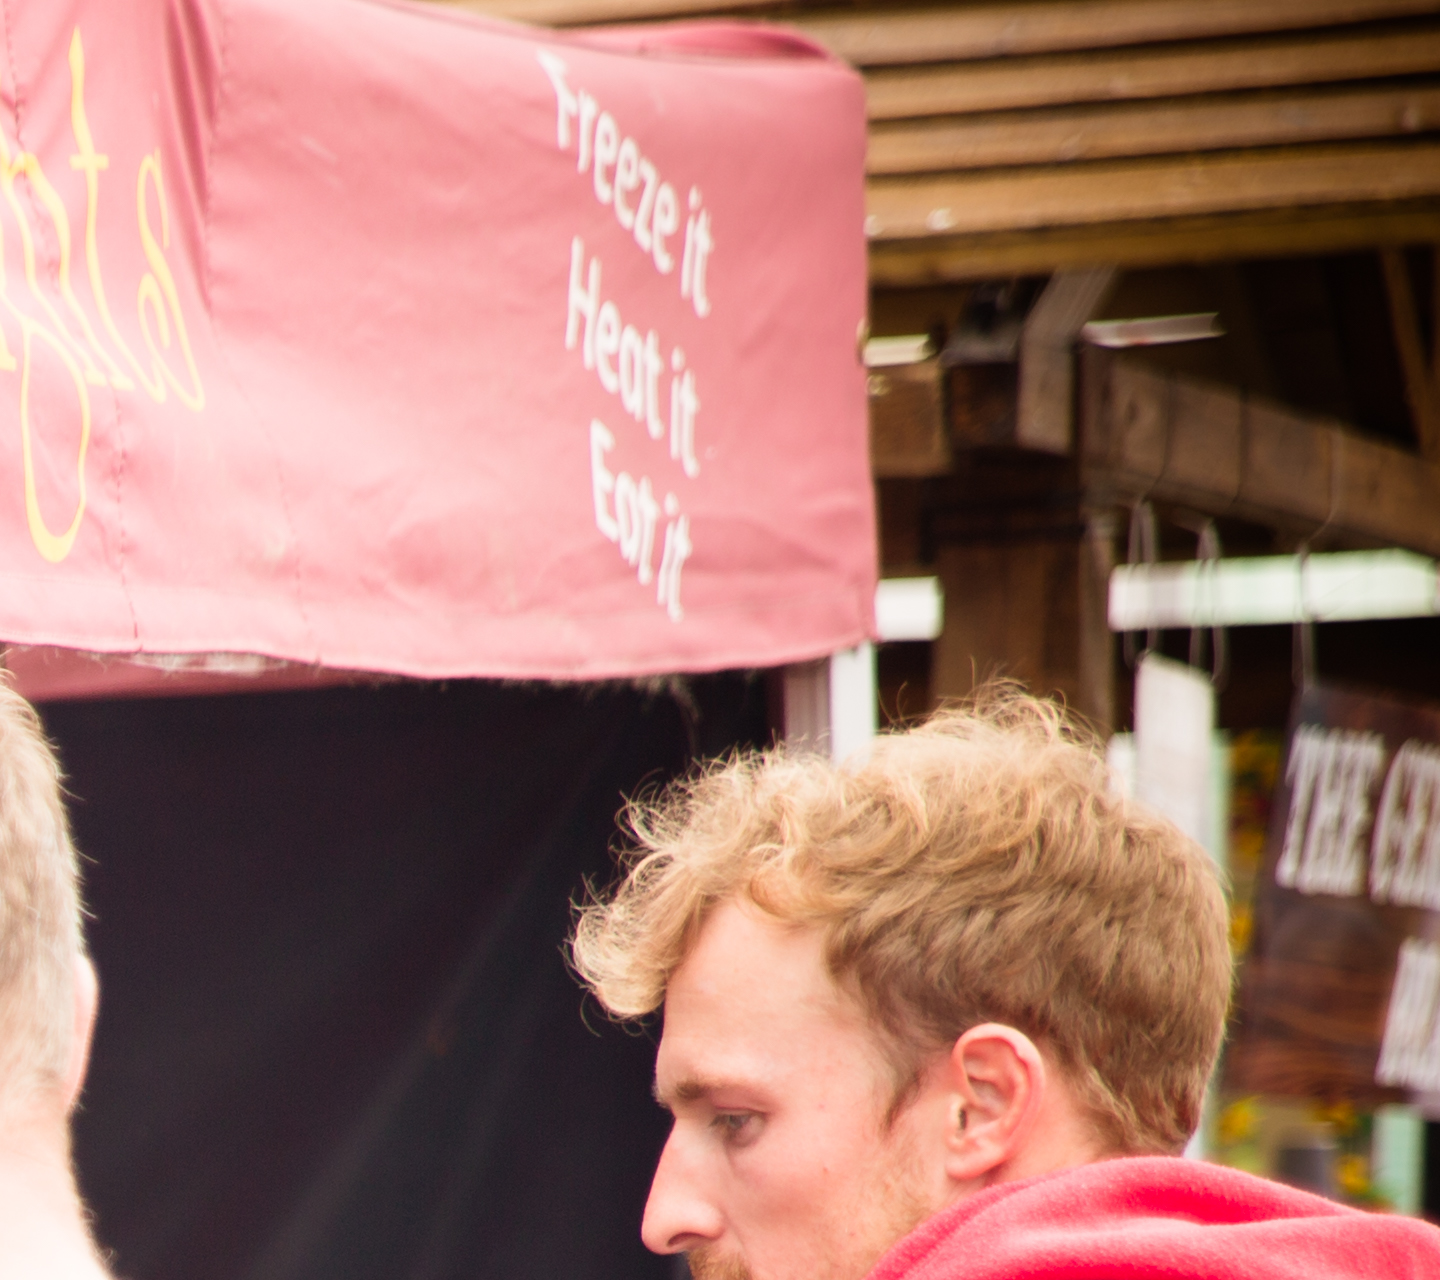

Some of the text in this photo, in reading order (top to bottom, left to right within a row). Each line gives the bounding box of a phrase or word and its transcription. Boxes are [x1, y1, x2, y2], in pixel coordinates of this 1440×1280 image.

[537, 46, 716, 318] Freeze it
[565, 235, 701, 478] Heat it
[590, 417, 693, 622] Eat it
